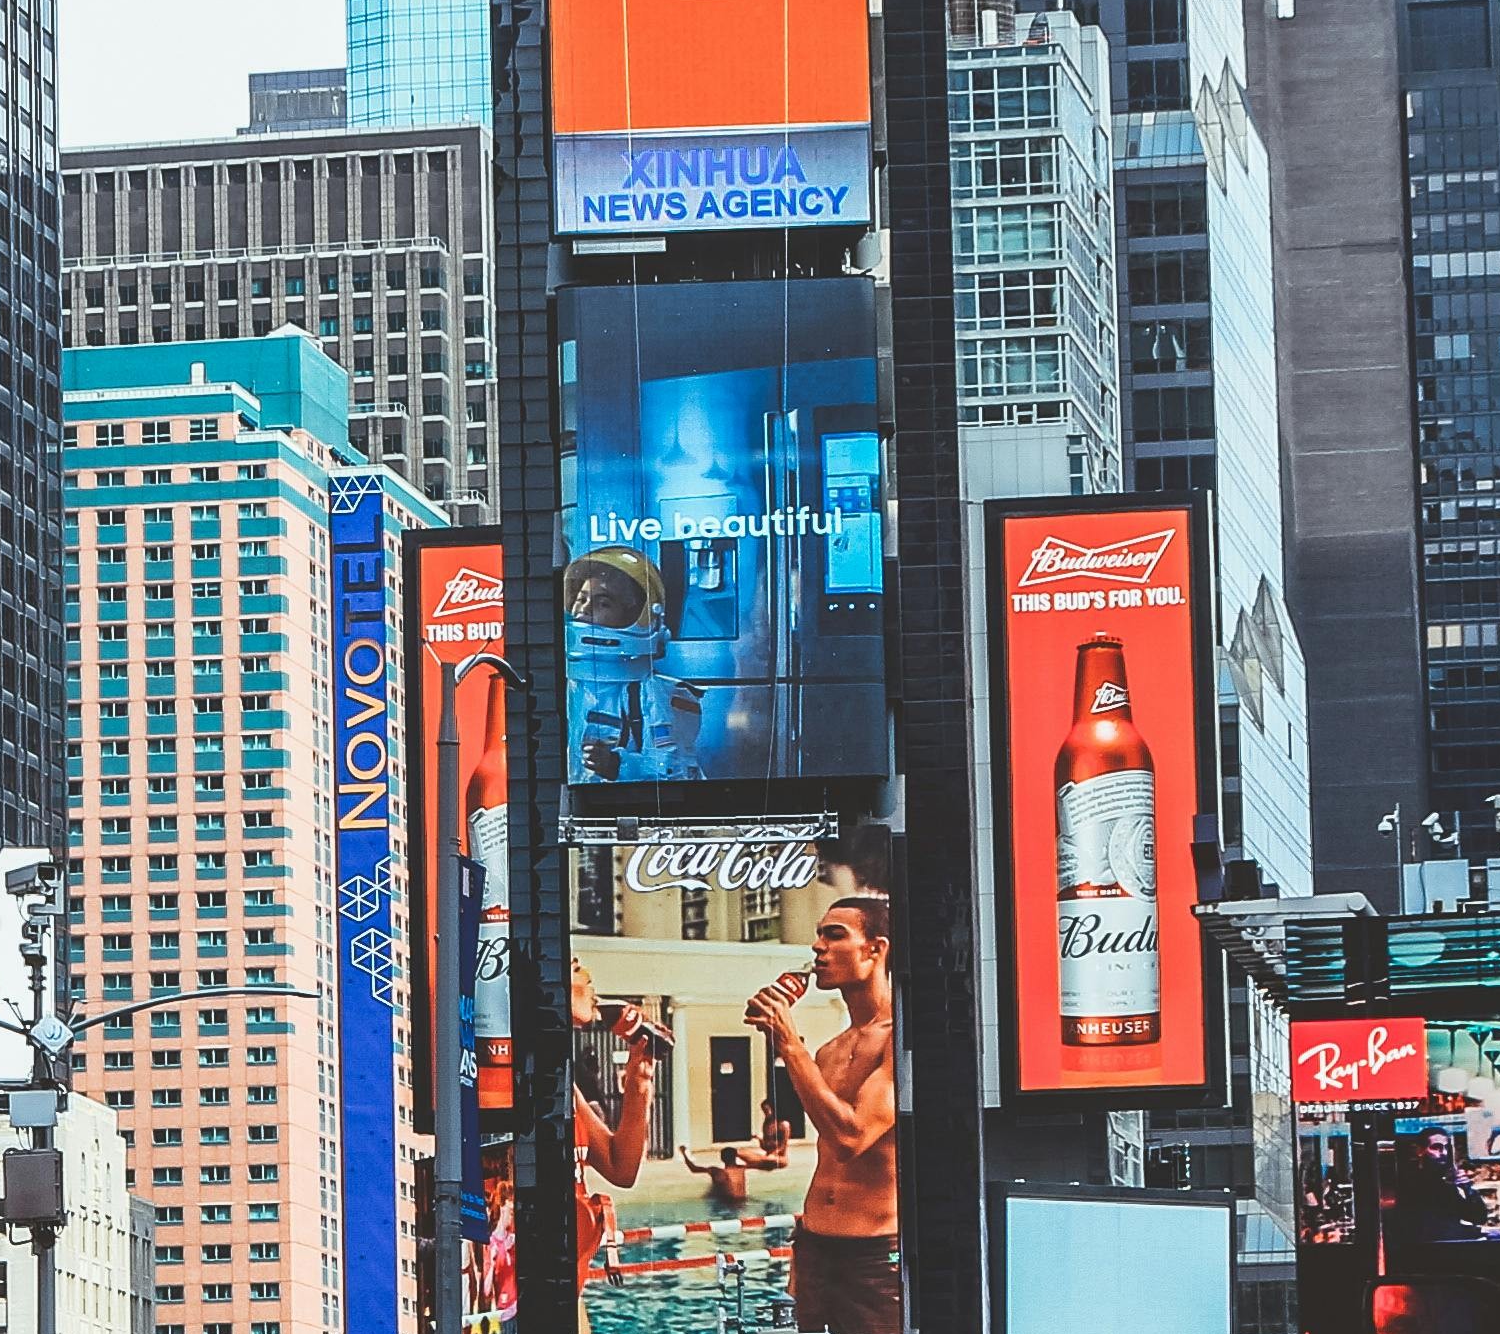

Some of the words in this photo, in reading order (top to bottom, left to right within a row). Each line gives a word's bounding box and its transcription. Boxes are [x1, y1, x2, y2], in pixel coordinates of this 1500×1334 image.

[623, 146, 806, 189] XINHUA
[583, 192, 687, 223] NEWS
[698, 185, 849, 220] AGENCY
[590, 513, 662, 543] Live
[673, 506, 843, 541] beautiful
[1031, 549, 1160, 572] Budweiser
[1011, 594, 1051, 612] THIS
[1054, 591, 1105, 611] BUD'S
[1108, 590, 1143, 607] FOR
[1146, 587, 1186, 606] YOU.
[426, 625, 464, 642] THIS
[337, 512, 388, 831] NOVOTEL
[1298, 1027, 1417, 1090] Ray-Ban
[1353, 1101, 1387, 1112] SINCE
[1391, 1100, 1420, 1111] 1937
